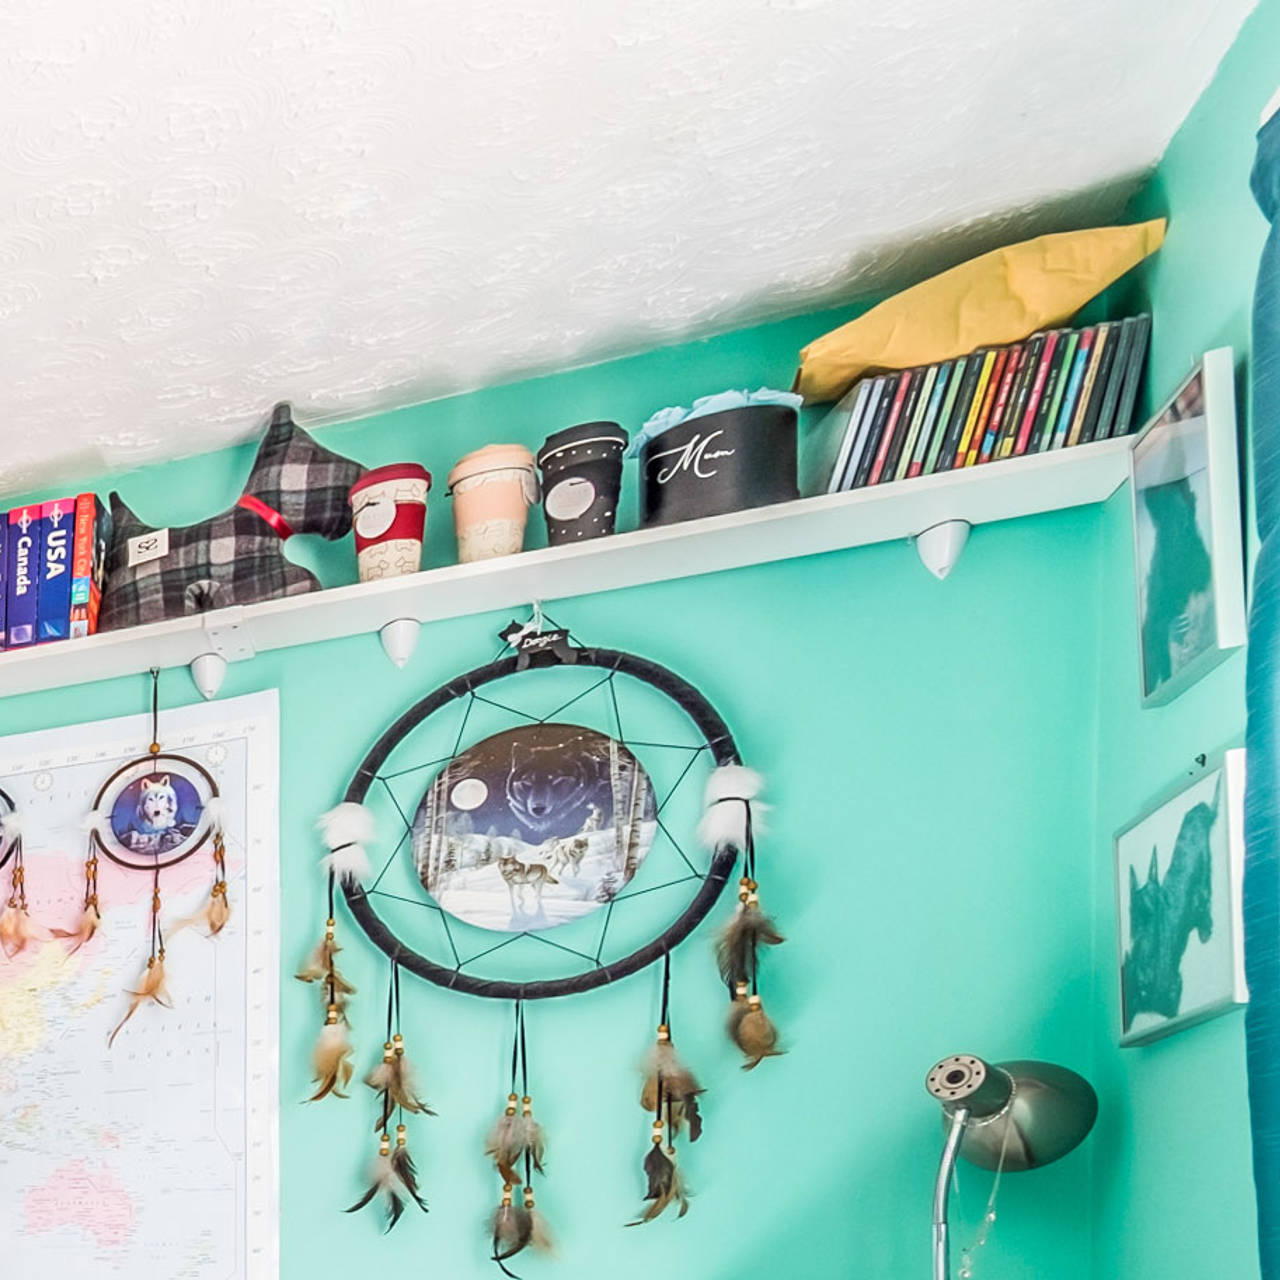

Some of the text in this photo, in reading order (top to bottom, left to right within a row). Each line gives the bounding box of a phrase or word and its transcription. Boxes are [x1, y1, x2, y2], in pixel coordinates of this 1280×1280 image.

[79, 513, 91, 536] New
[16, 536, 32, 596] Canada
[46, 530, 66, 580] USA
